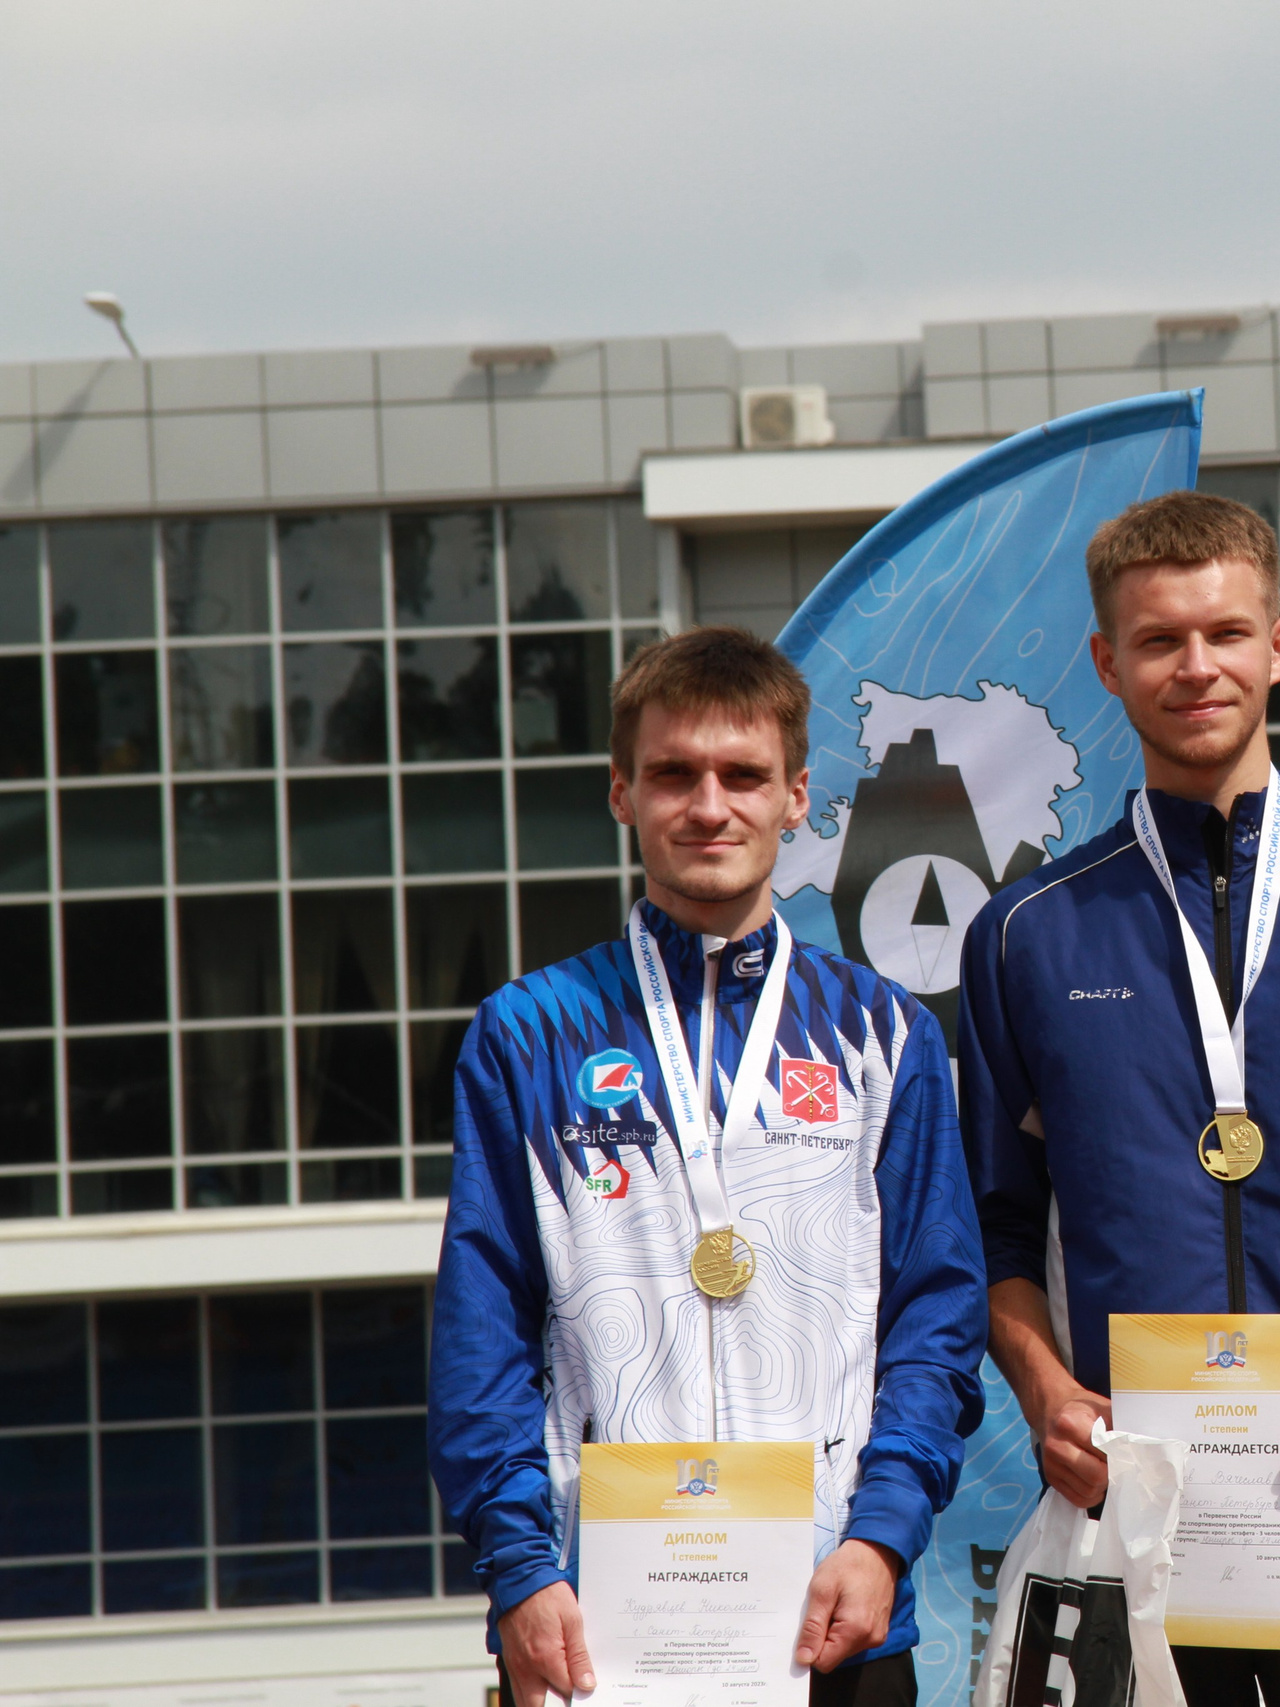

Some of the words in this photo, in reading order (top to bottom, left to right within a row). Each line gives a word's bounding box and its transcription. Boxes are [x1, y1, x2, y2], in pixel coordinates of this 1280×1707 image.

[656, 1001, 675, 1044] СПОРТА
[665, 1044, 695, 1123] МИНИСТЕРСТВО
[585, 1177, 612, 1193] SFR
[1195, 1405, 1258, 1418] ДИПЛОМ
[1189, 1443, 1279, 1456] АГРАЖДАЕТСЯ
[664, 1533, 727, 1546] ДИПЛОМ
[648, 1572, 748, 1584] НАГРАЖДАЕТСЯ
